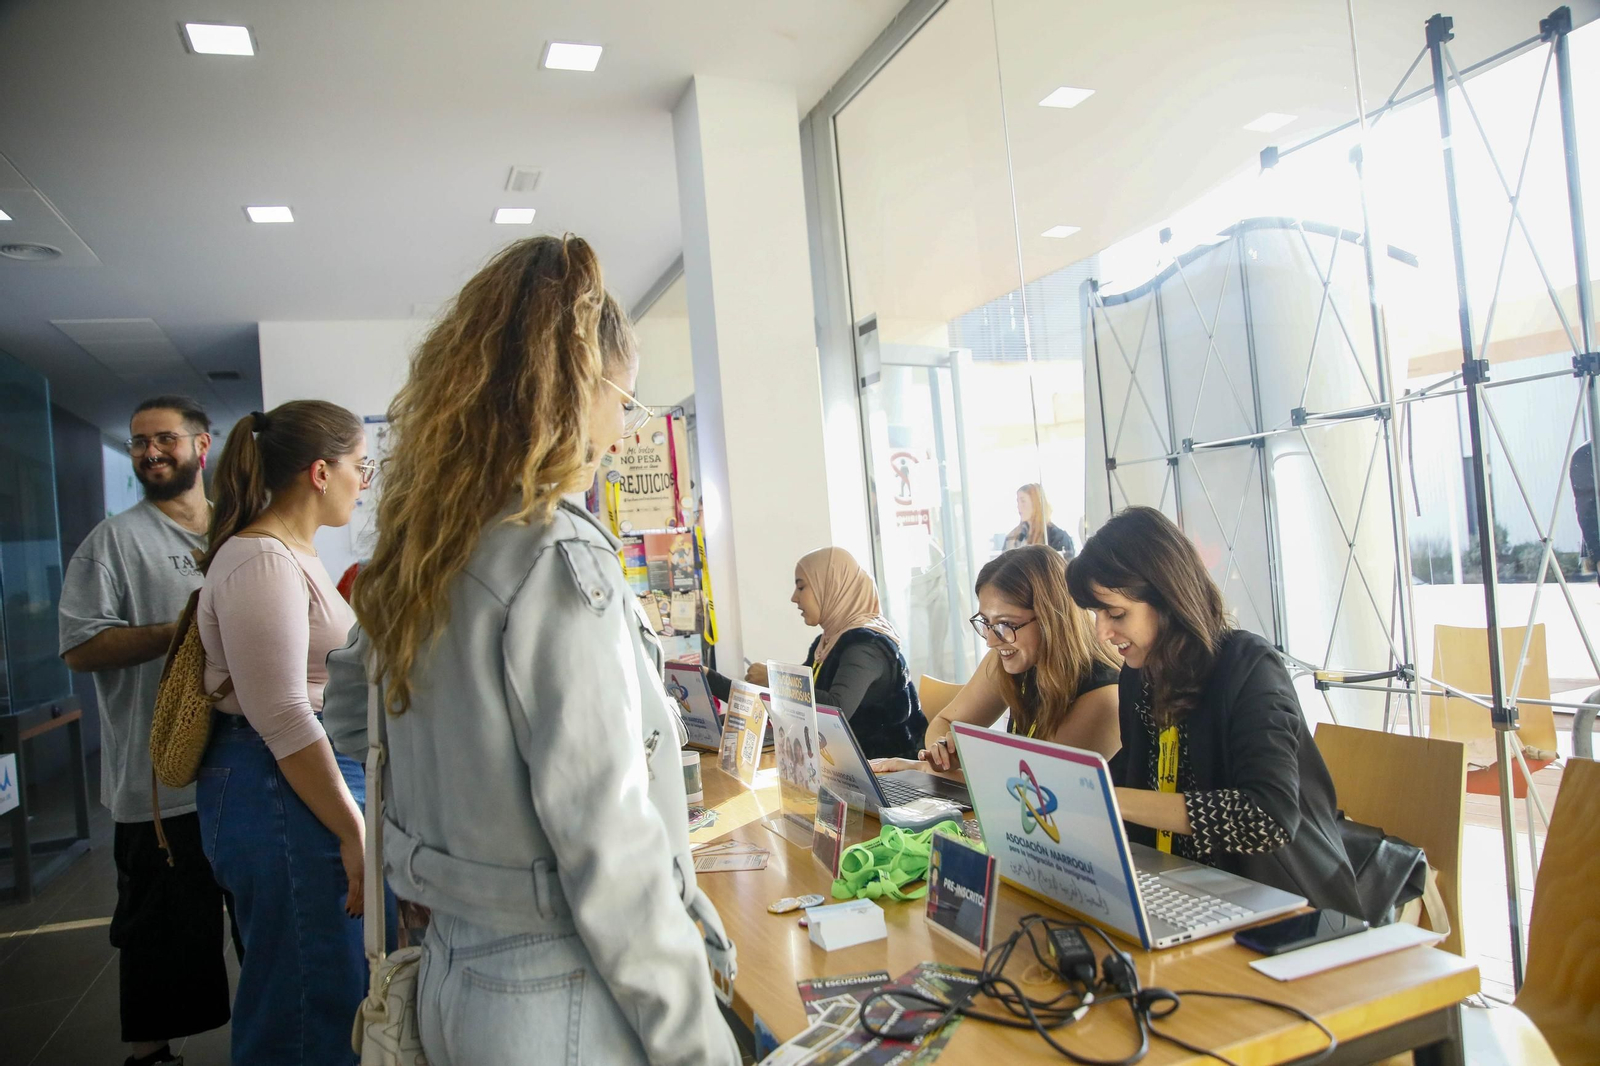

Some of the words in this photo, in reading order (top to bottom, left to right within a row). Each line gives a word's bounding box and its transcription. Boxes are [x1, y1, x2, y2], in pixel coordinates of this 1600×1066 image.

[620, 455, 635, 465] NO
[637, 454, 662, 463] PESA
[619, 472, 675, 494] REJUICIOS
[167, 555, 196, 570] TA
[1006, 832, 1049, 857] ASOCIACIÓN
[1050, 849, 1094, 875] MARROQUÍ
